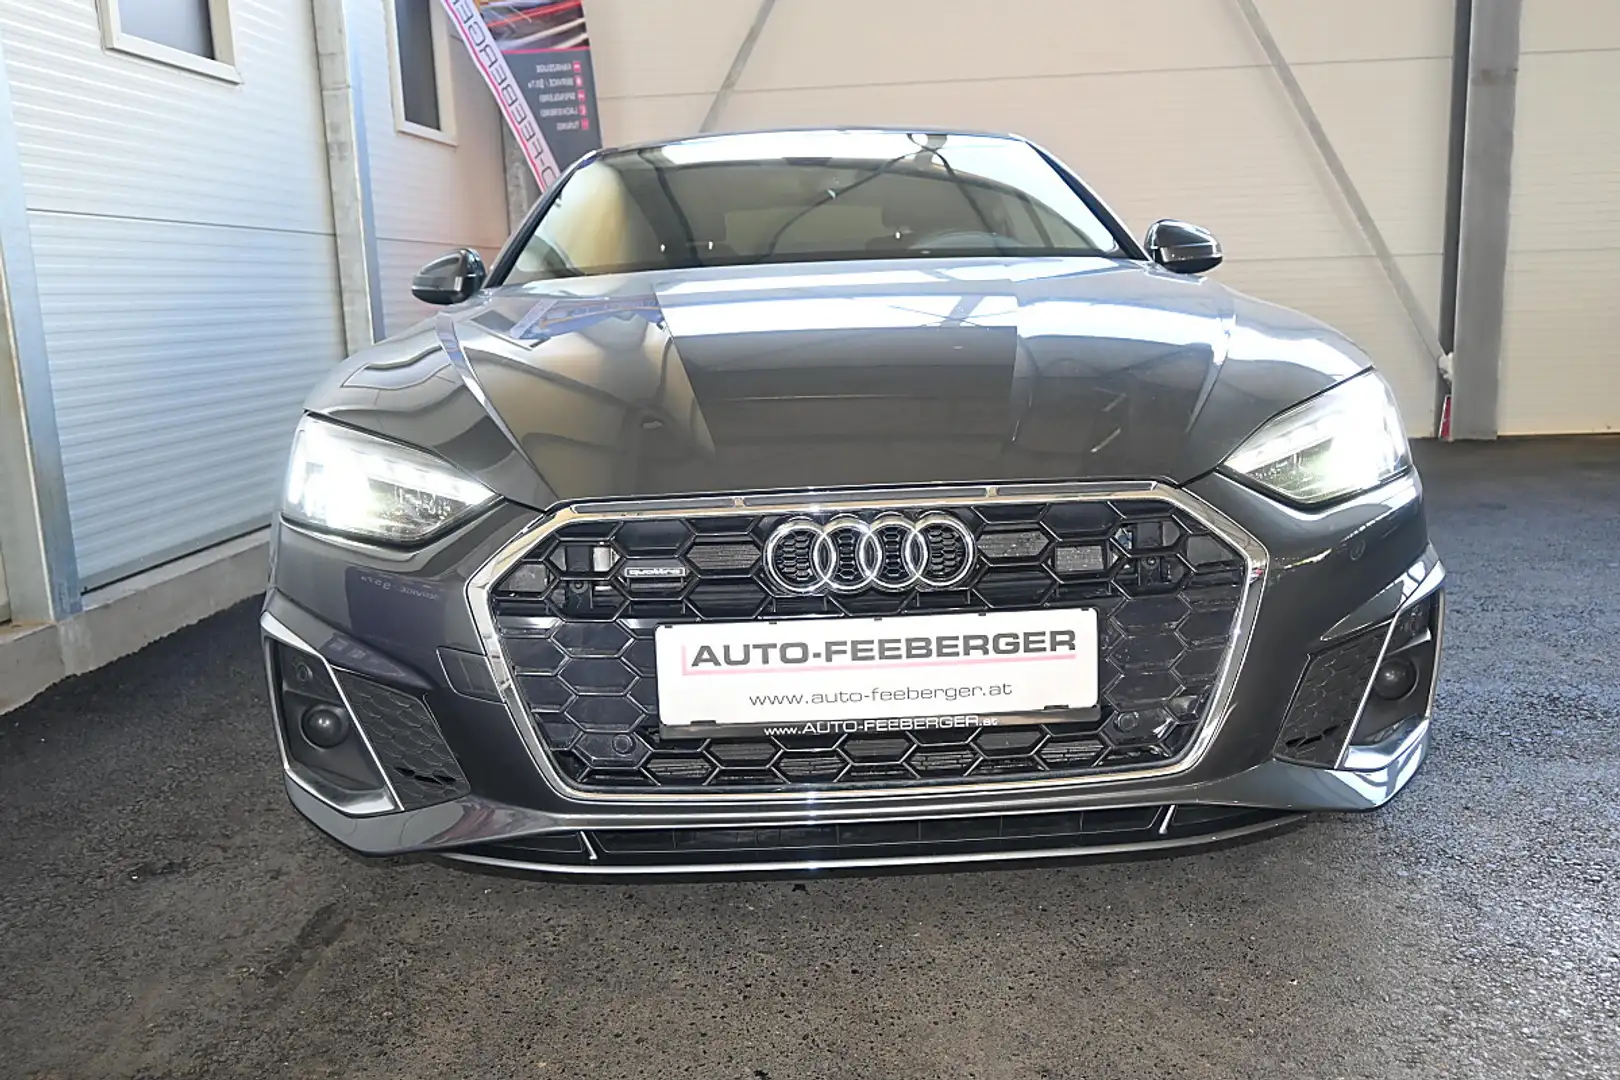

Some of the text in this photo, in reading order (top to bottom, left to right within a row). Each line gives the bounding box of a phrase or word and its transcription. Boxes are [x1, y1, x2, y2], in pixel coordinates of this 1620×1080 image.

[690, 629, 1077, 668] AUTO-FEEBERGER
[748, 682, 1013, 707] www.auto-feeberger.at
[763, 714, 998, 737] www.AUTO-FEEBERGER.at
